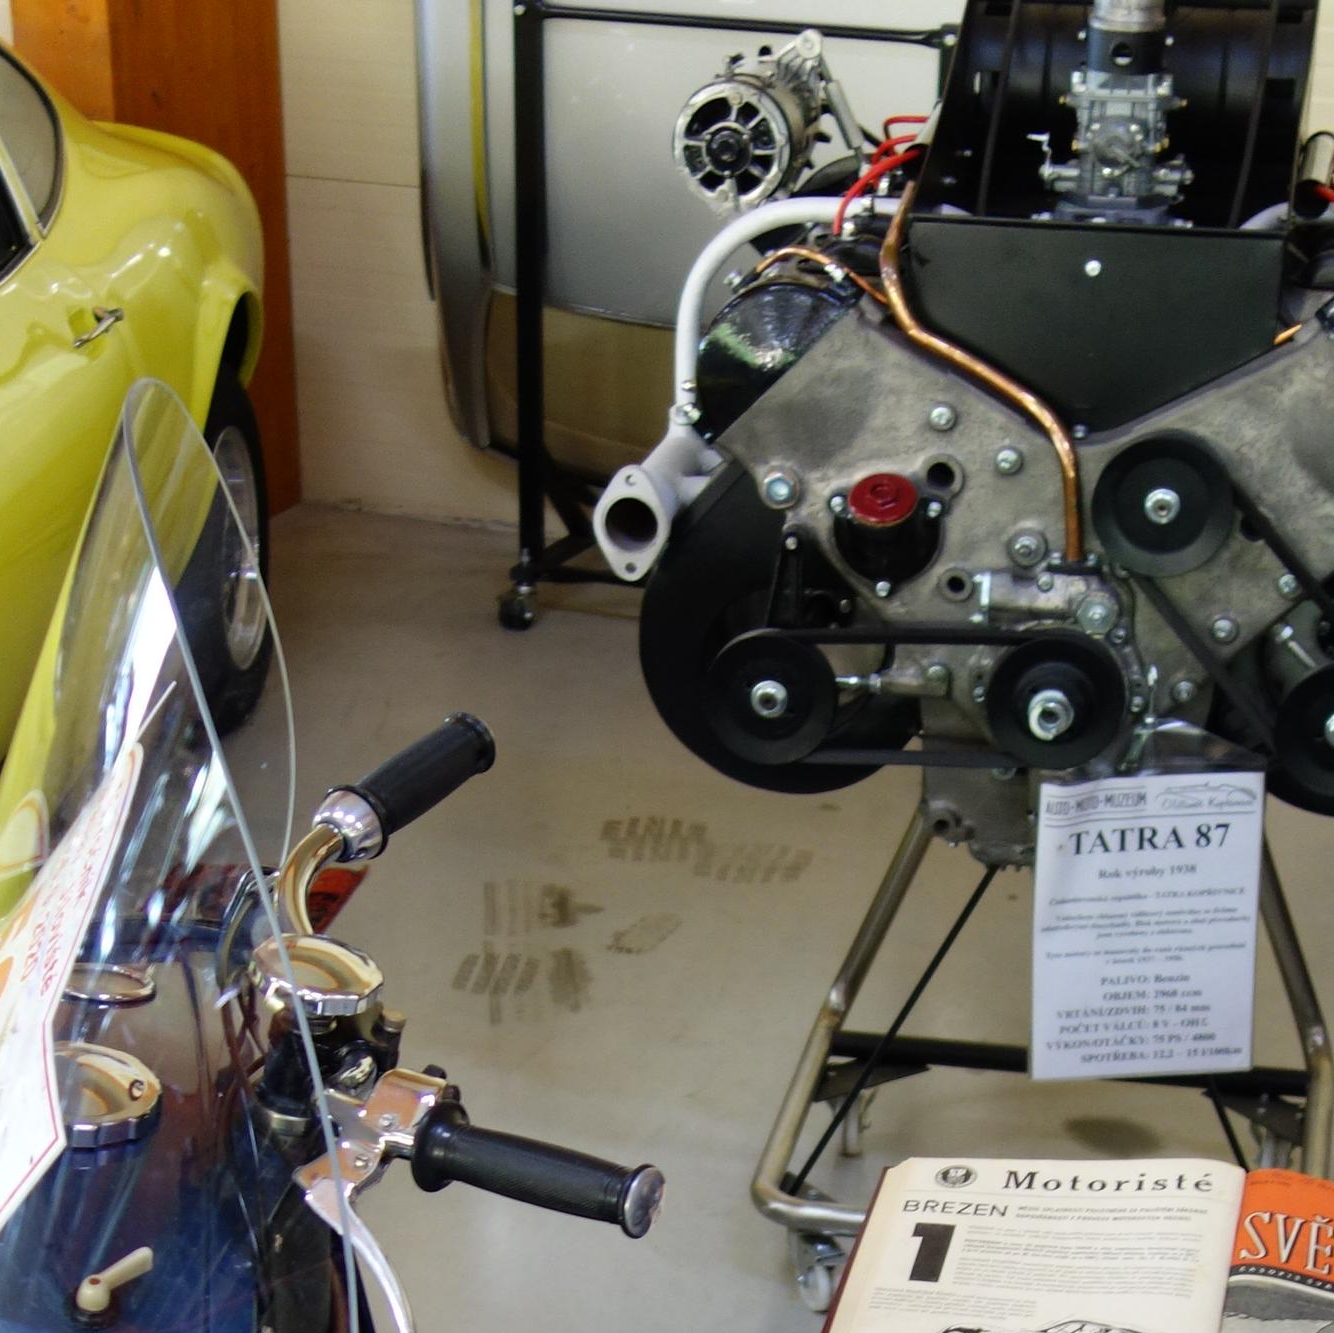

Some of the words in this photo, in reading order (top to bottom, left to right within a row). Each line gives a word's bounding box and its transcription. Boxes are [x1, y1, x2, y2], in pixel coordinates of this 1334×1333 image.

[1069, 828, 1184, 856] TATRA
[1196, 823, 1231, 849] 87
[1002, 1170, 1214, 1193] Motoristé
[902, 1199, 1009, 1217] BREZEN
[908, 1222, 957, 1283] 1
